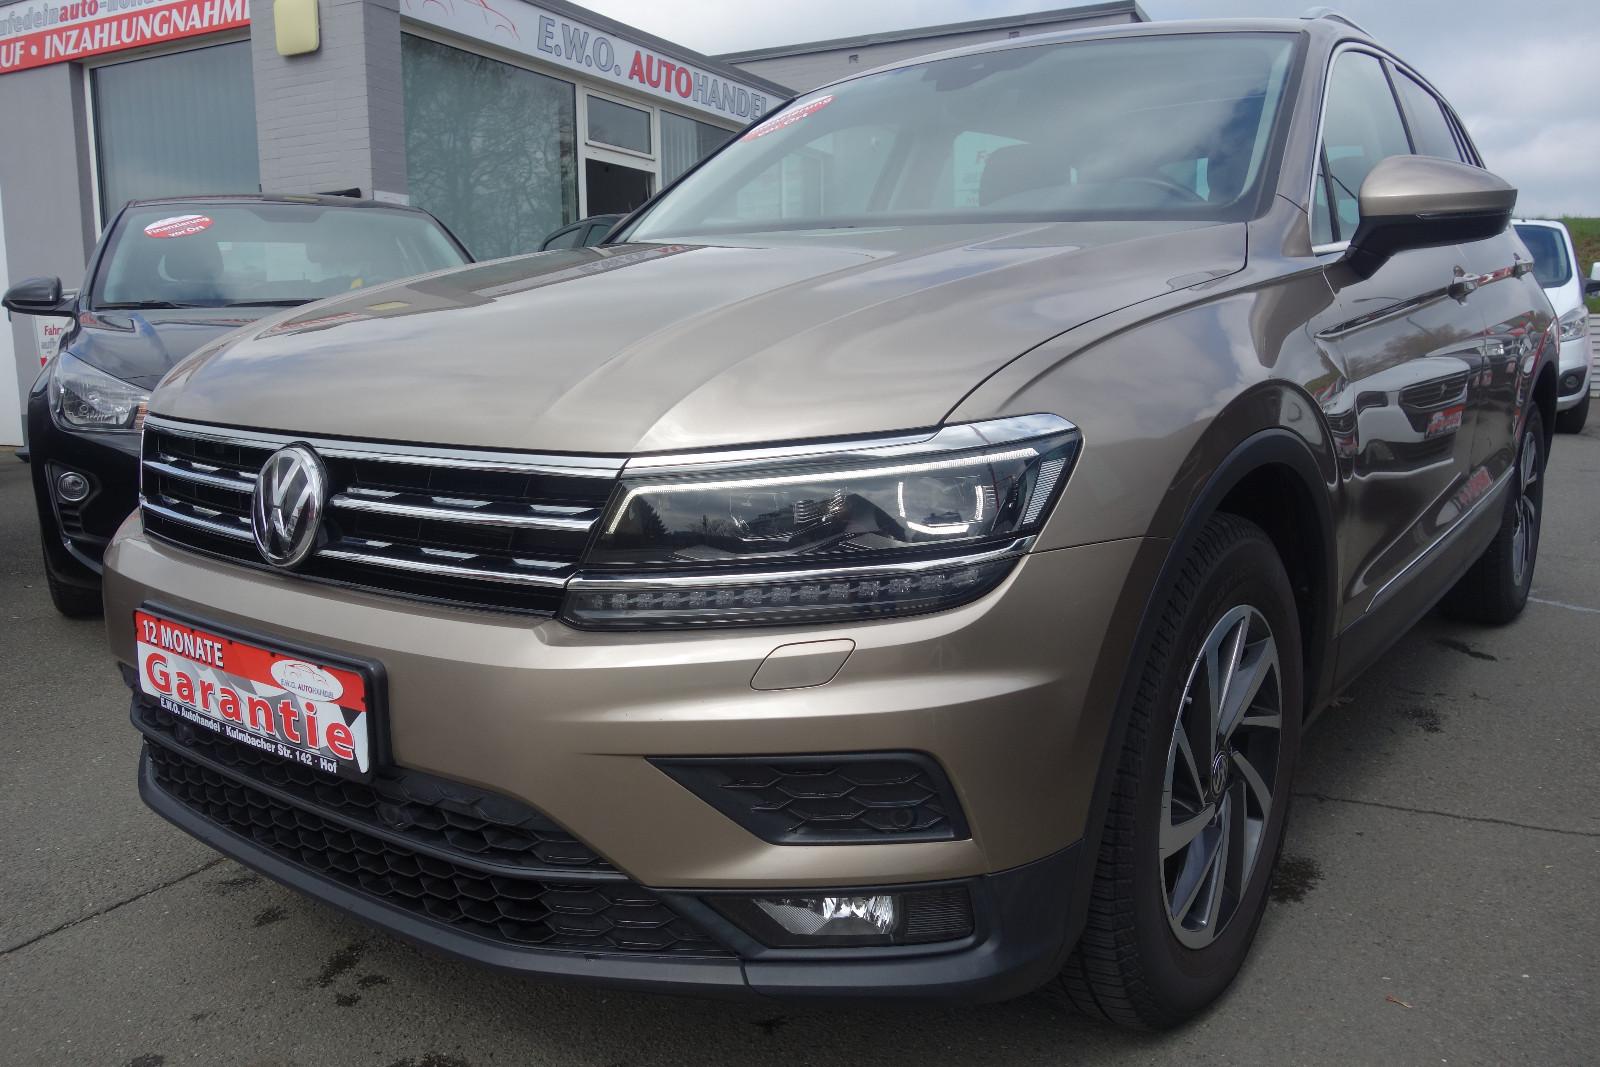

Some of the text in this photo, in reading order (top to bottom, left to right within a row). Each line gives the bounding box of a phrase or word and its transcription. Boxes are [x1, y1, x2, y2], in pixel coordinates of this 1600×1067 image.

[0, 40, 25, 68] UF
[537, 15, 622, 77] E.W.O.
[143, 619, 225, 668] 12 MONATE
[145, 652, 356, 761] Garantie
[160, 698, 338, 774] E.W.O. Autohandel Kulmbacher Str. 142 Hof
